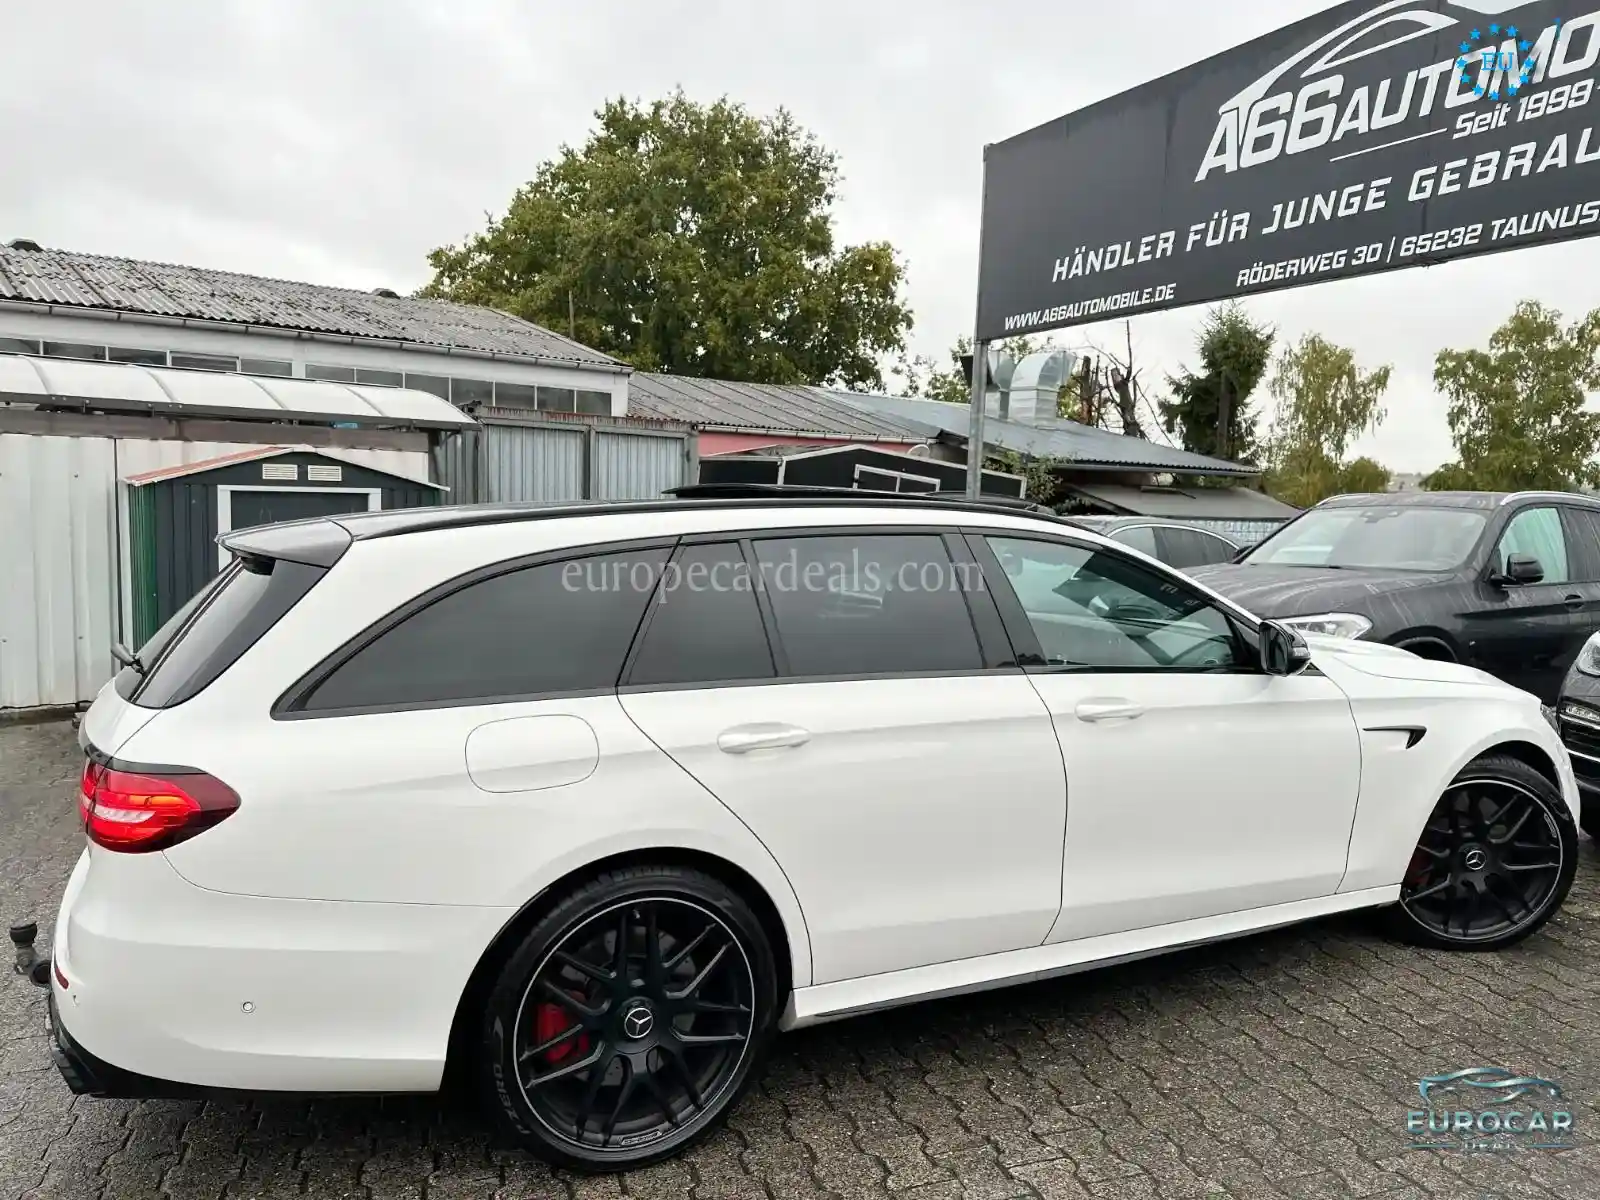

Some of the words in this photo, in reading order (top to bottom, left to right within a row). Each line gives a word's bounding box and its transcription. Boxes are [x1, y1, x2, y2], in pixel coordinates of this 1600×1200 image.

[1452, 102, 1512, 140] Seit
[1516, 78, 1595, 122] 1999
[1051, 230, 1176, 283] HÄNDLER
[1185, 209, 1251, 252] FÜR
[1261, 176, 1393, 235] JUNGE
[1235, 249, 1348, 287] RÖDERWEG
[1351, 242, 1384, 266] 30
[1399, 223, 1483, 257] 65232
[1004, 283, 1177, 330] WWW.A66AUTOMOBILE.DE
